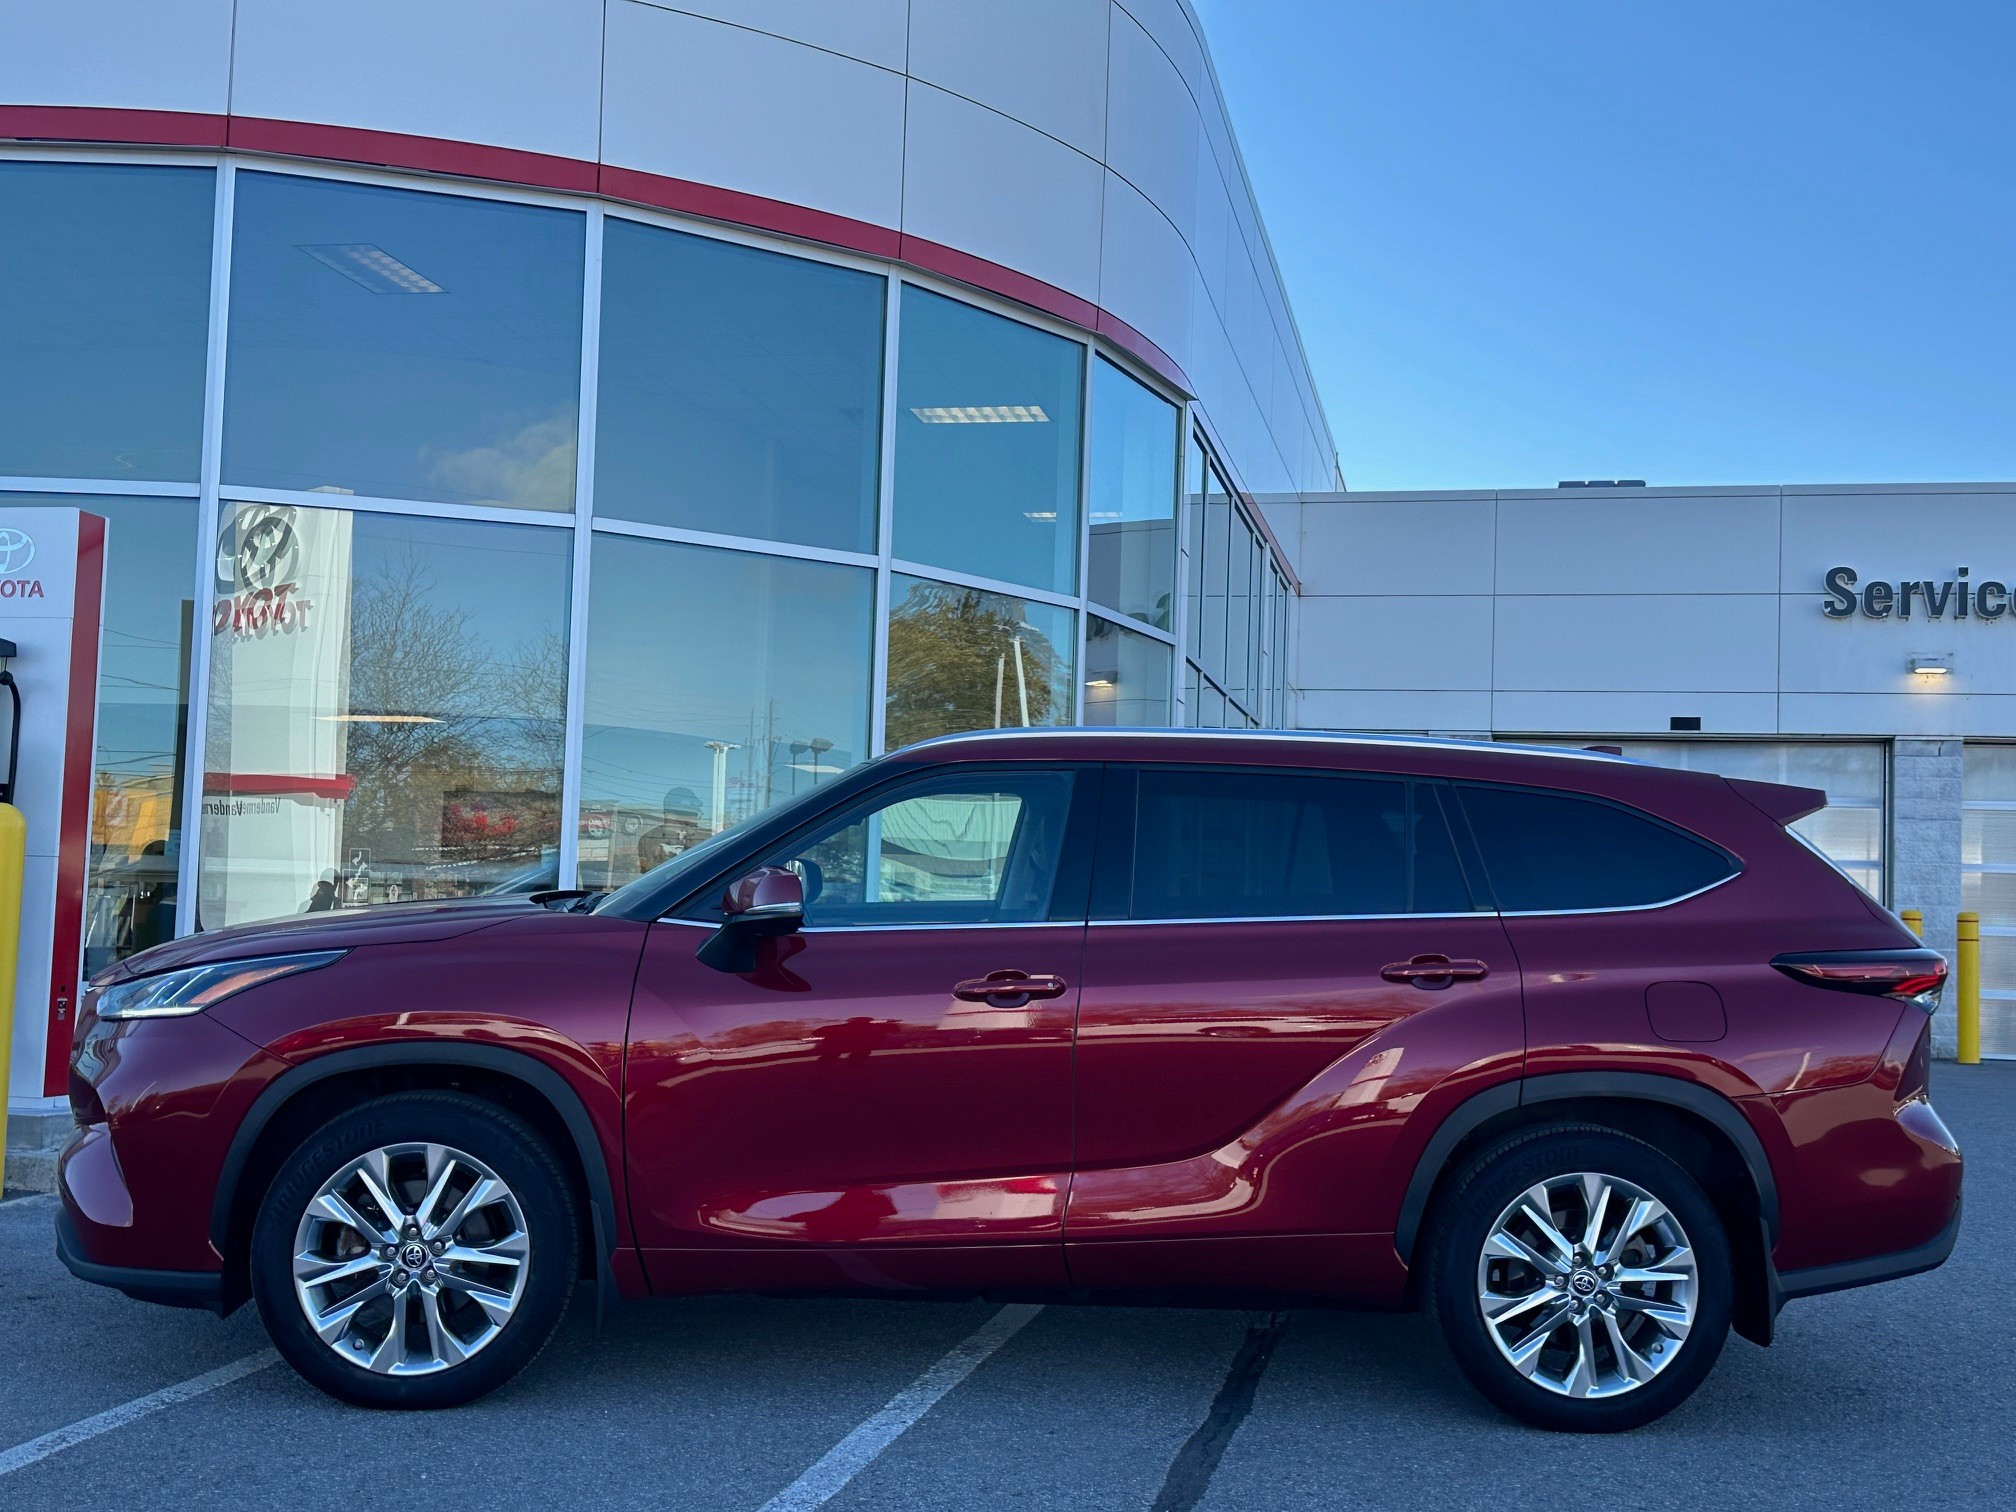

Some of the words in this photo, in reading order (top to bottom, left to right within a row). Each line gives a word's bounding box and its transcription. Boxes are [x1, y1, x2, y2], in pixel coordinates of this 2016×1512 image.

[0, 579, 45, 598] OTA
[1823, 565, 2016, 619] Servic
[269, 1118, 388, 1226] BRIDGESTONE
